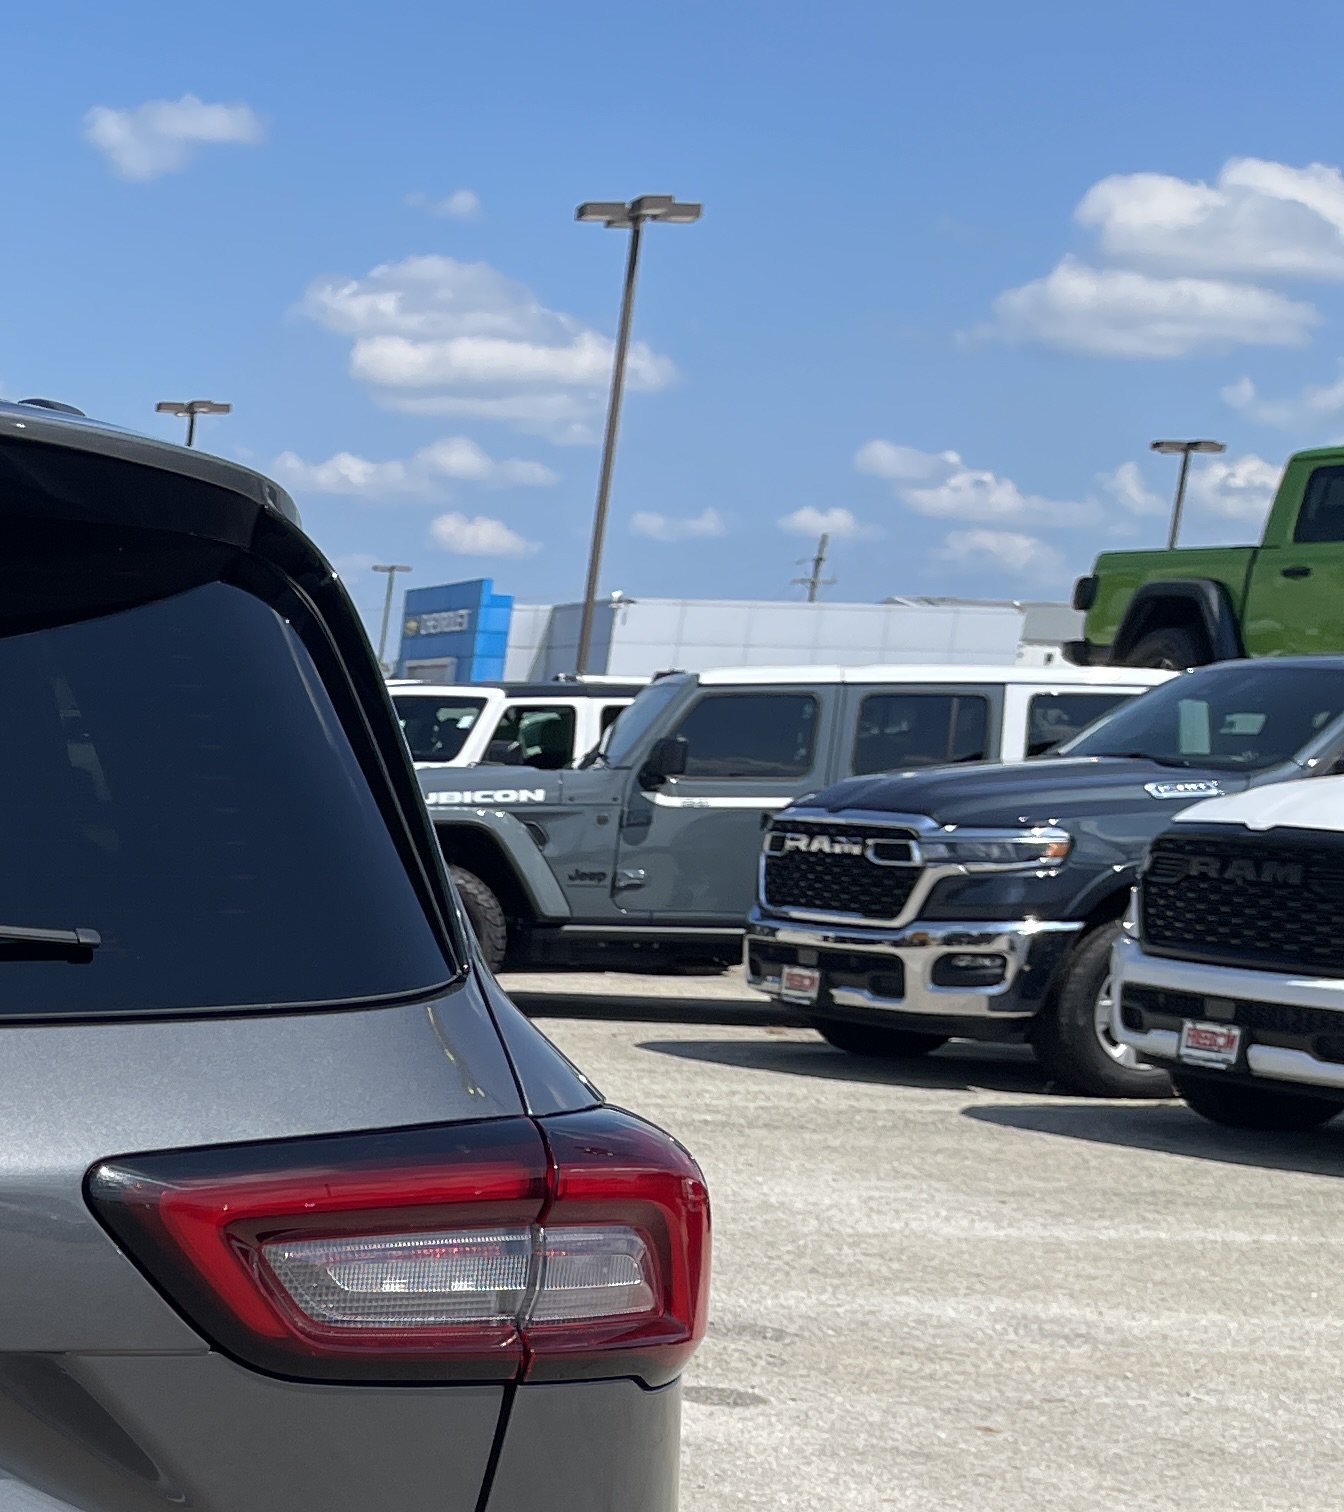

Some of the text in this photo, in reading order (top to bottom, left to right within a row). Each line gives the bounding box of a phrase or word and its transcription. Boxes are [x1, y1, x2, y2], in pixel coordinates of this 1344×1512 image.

[425, 789, 546, 804] UBICON
[784, 832, 863, 856] RAM
[1186, 856, 1304, 885] RAM
